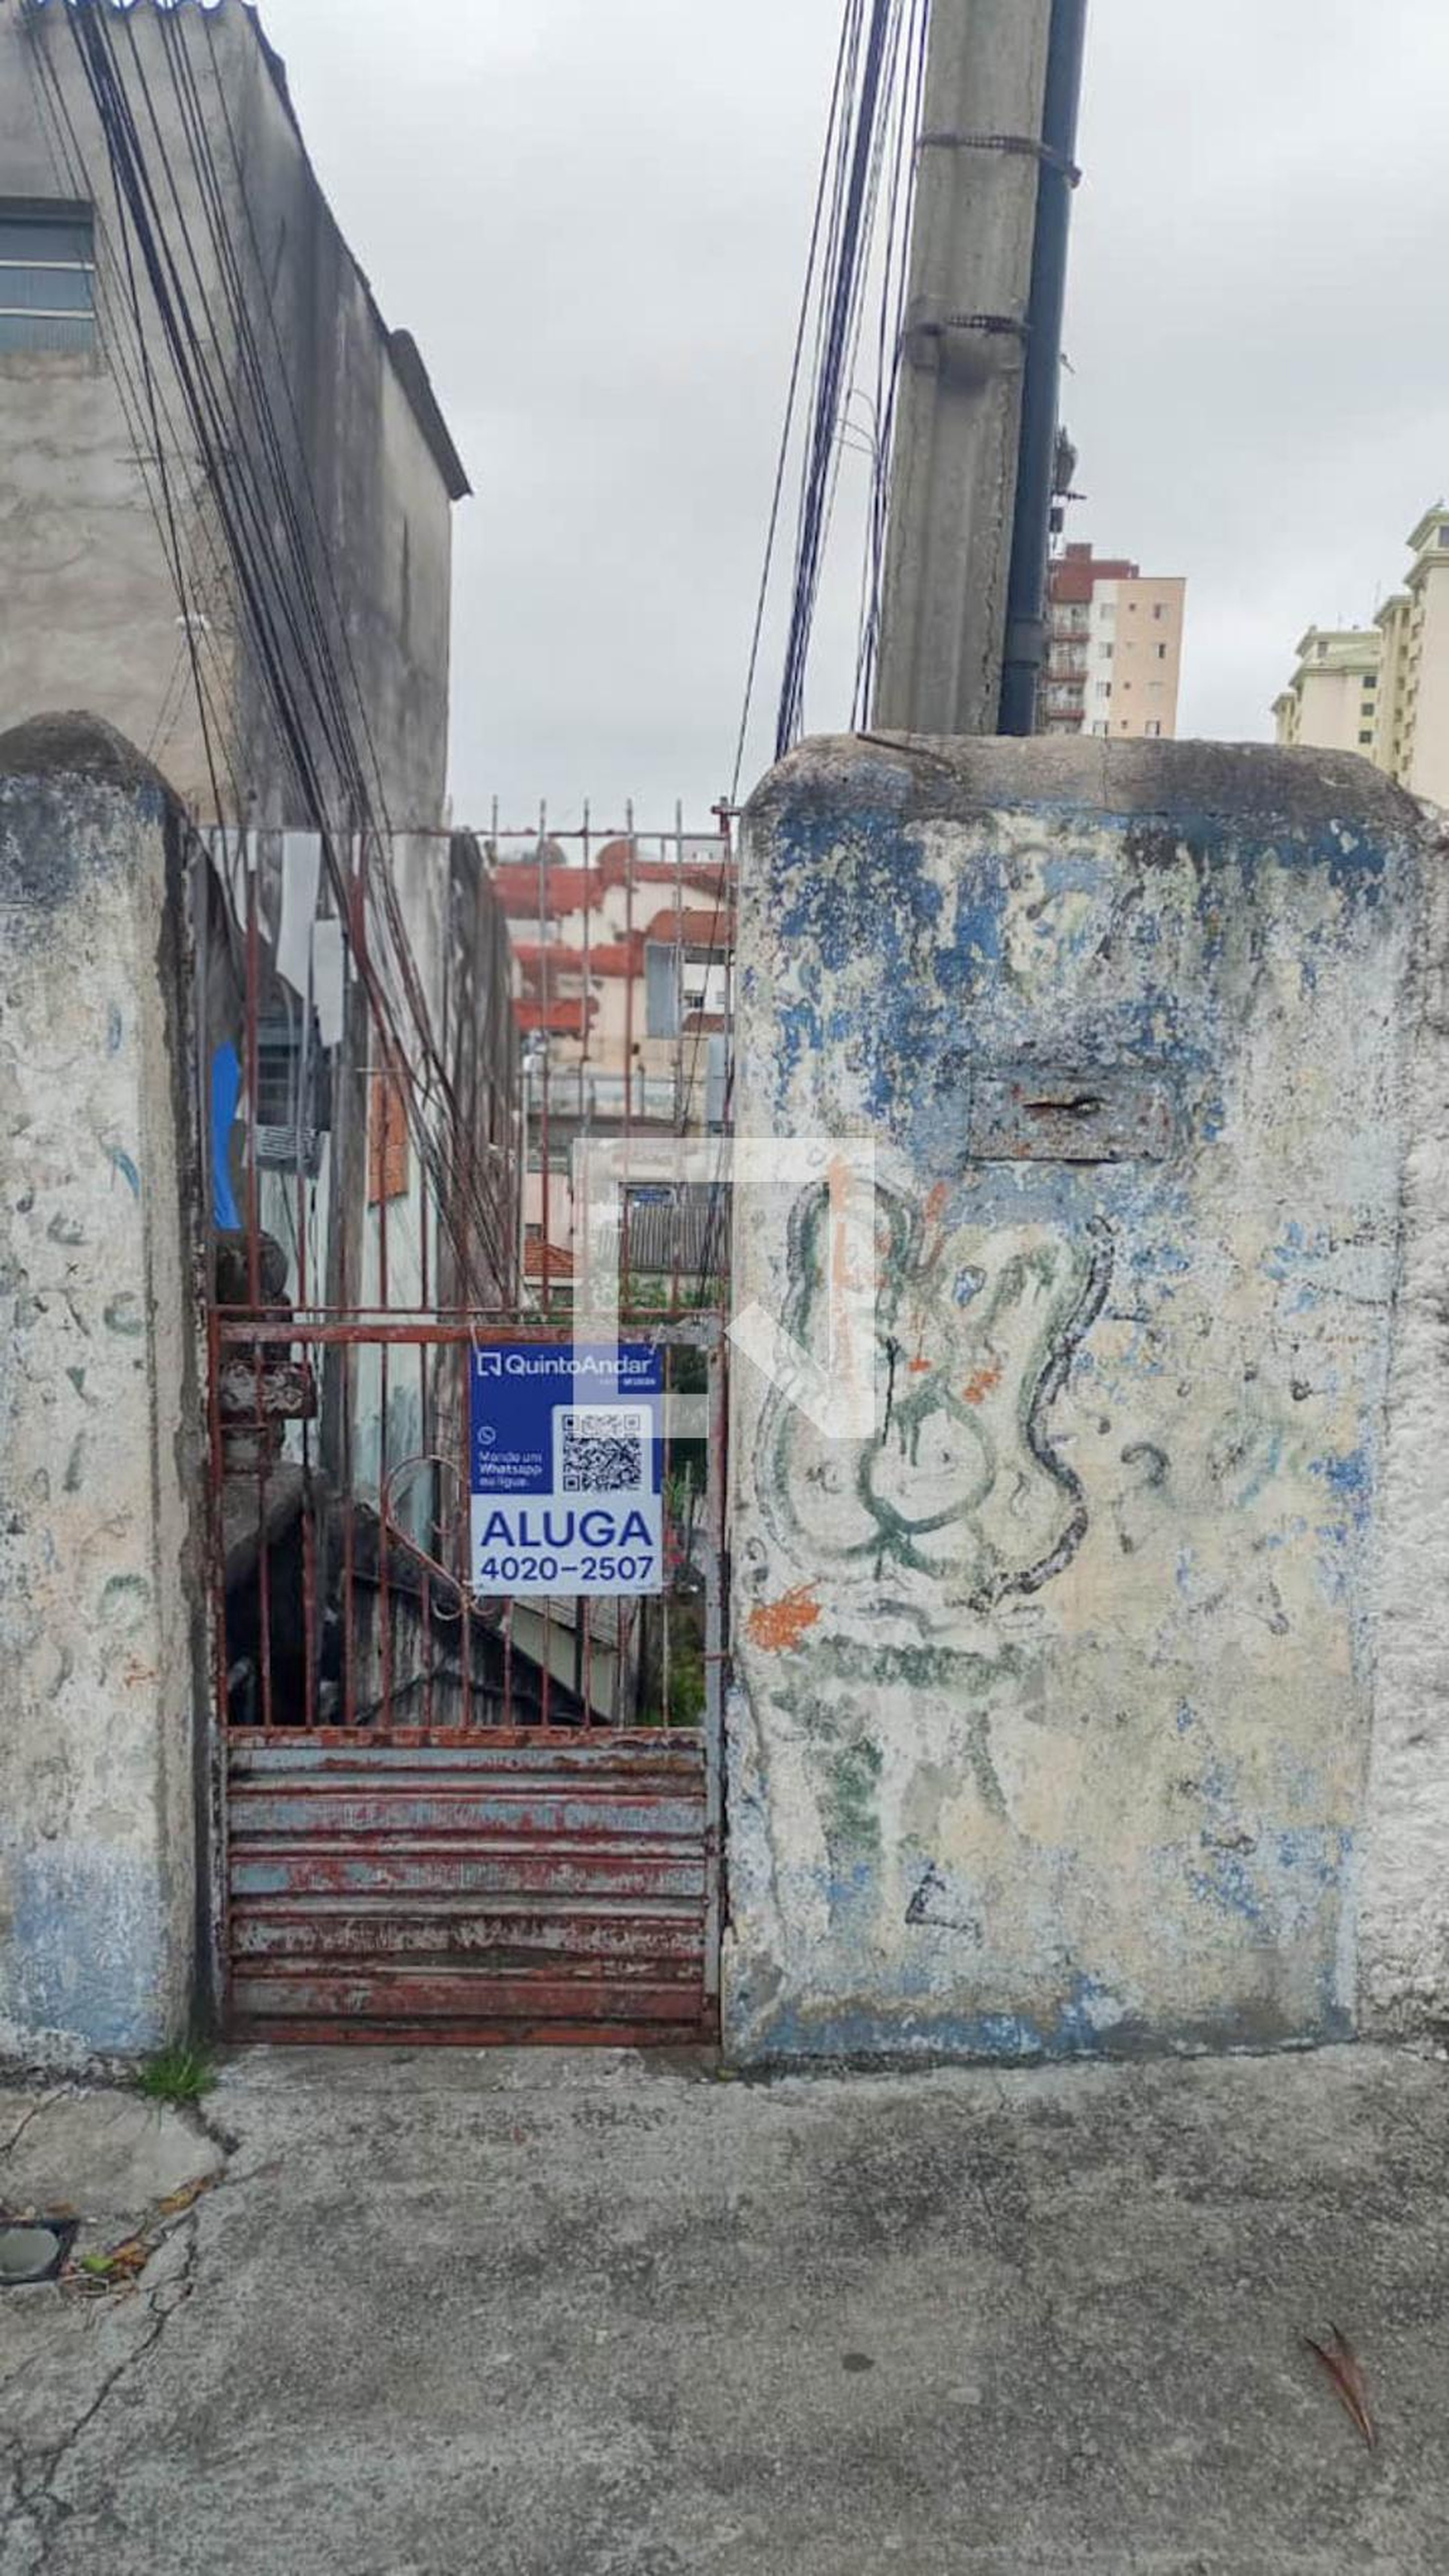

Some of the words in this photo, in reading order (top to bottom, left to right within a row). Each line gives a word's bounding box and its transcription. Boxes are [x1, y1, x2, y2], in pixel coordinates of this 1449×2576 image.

[505, 1354, 652, 1375] QuintoAndar
[480, 1510, 653, 1547] ALUGA
[480, 1556, 654, 1581] 4020-2507
